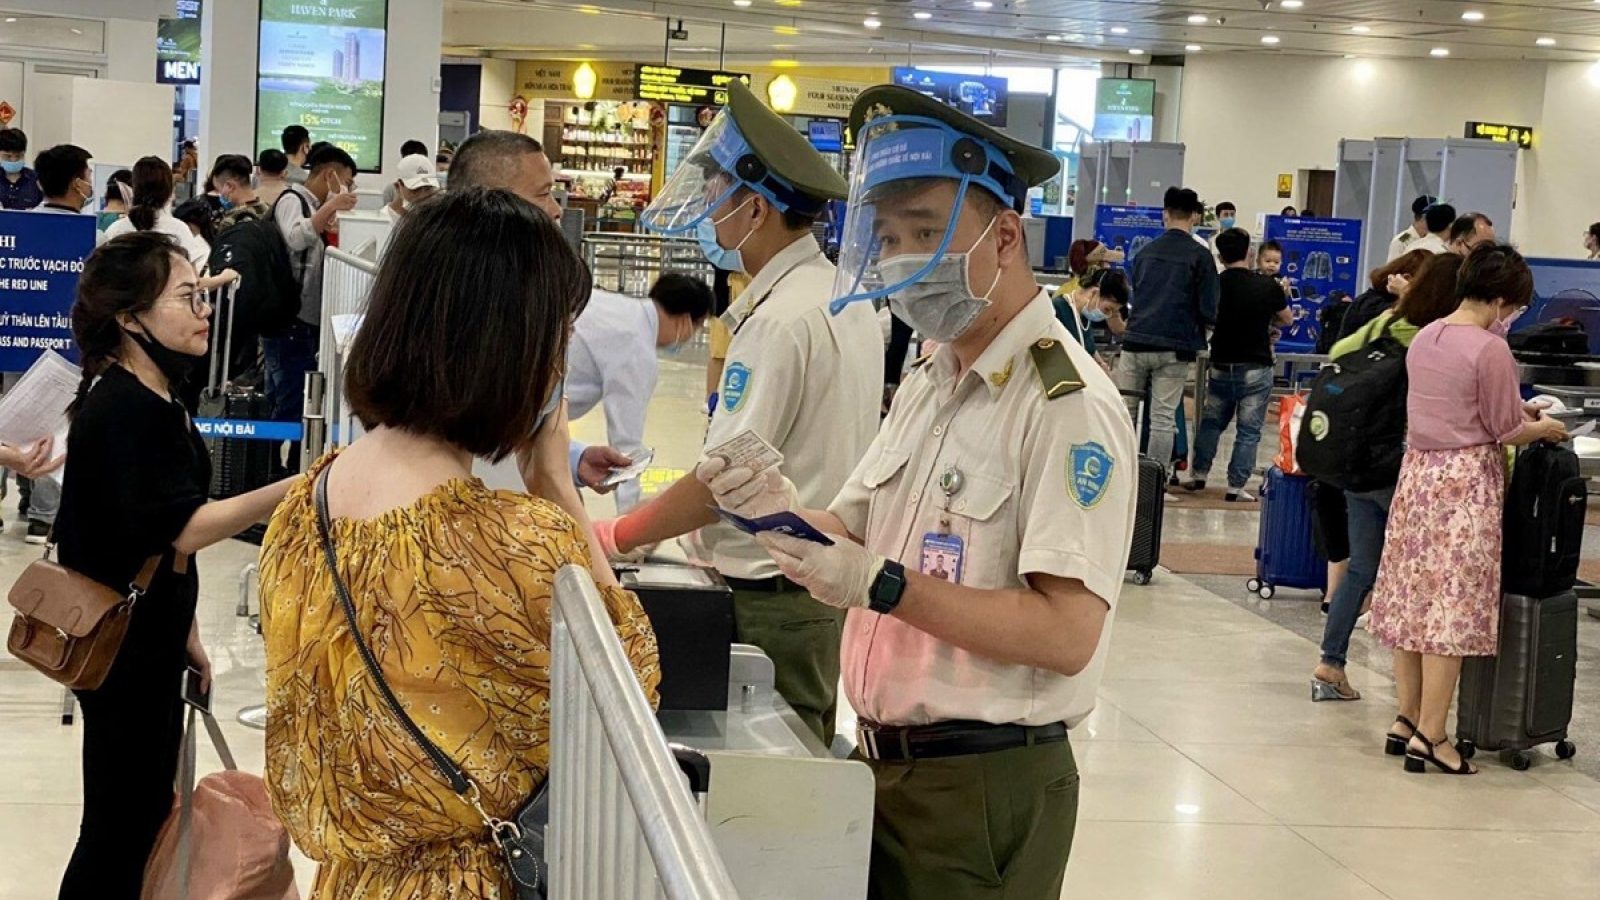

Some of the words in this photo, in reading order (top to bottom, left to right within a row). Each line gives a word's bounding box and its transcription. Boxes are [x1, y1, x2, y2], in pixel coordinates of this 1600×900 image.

[291, 4, 326, 17] HAVEN
[328, 7, 356, 19] PARK
[300, 113, 320, 126] 15%
[42, 259, 68, 274] VẠCH
[11, 279, 28, 290] RED
[30, 280, 48, 291] LINE
[34, 313, 50, 328] LÊN
[12, 337, 29, 347] AND
[30, 338, 72, 350] PASSPORT
[214, 421, 233, 436] NỘI
[235, 422, 256, 435] BÀI
